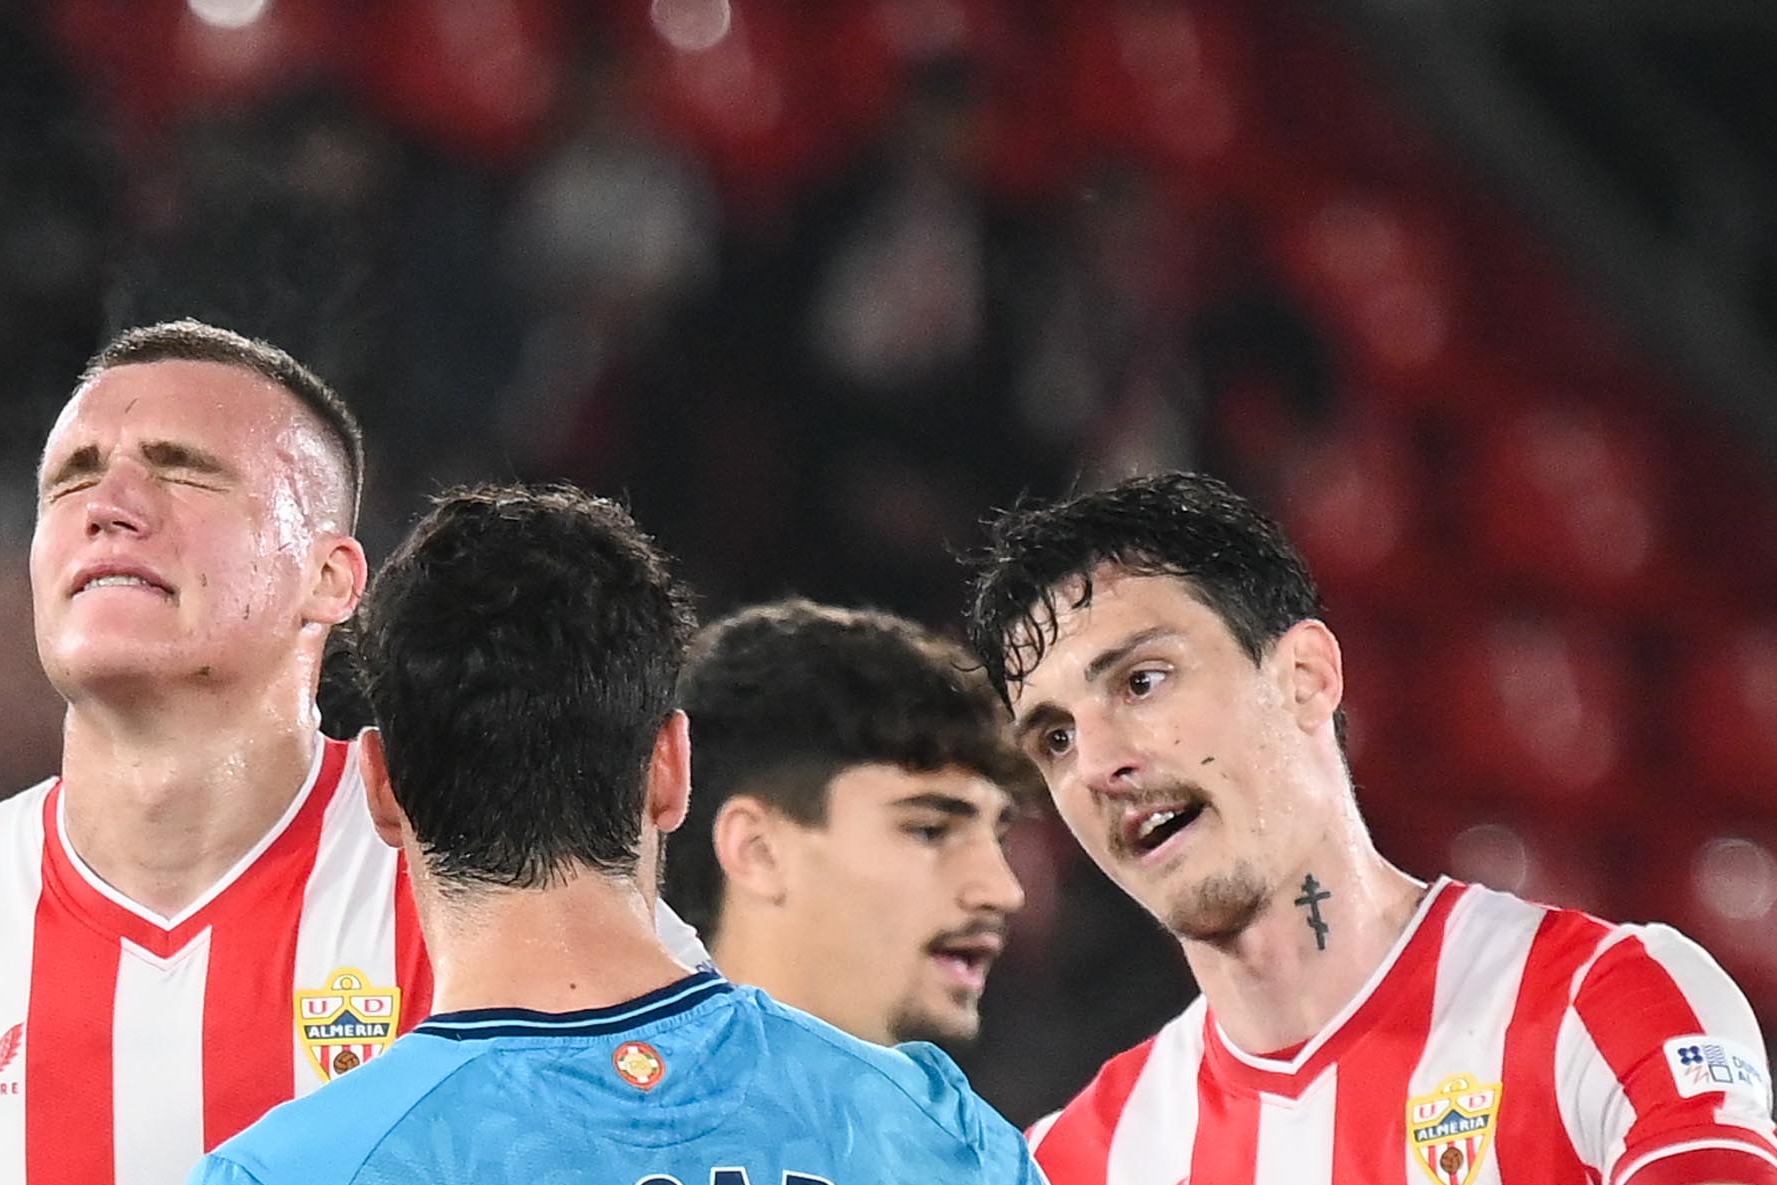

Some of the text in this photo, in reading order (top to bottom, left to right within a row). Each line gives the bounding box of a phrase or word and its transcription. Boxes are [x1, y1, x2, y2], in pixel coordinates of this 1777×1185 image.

[308, 998, 384, 1015] U D
[308, 1024, 385, 1038] ALMERIA
[1416, 1116, 1486, 1142] ALMERIA
